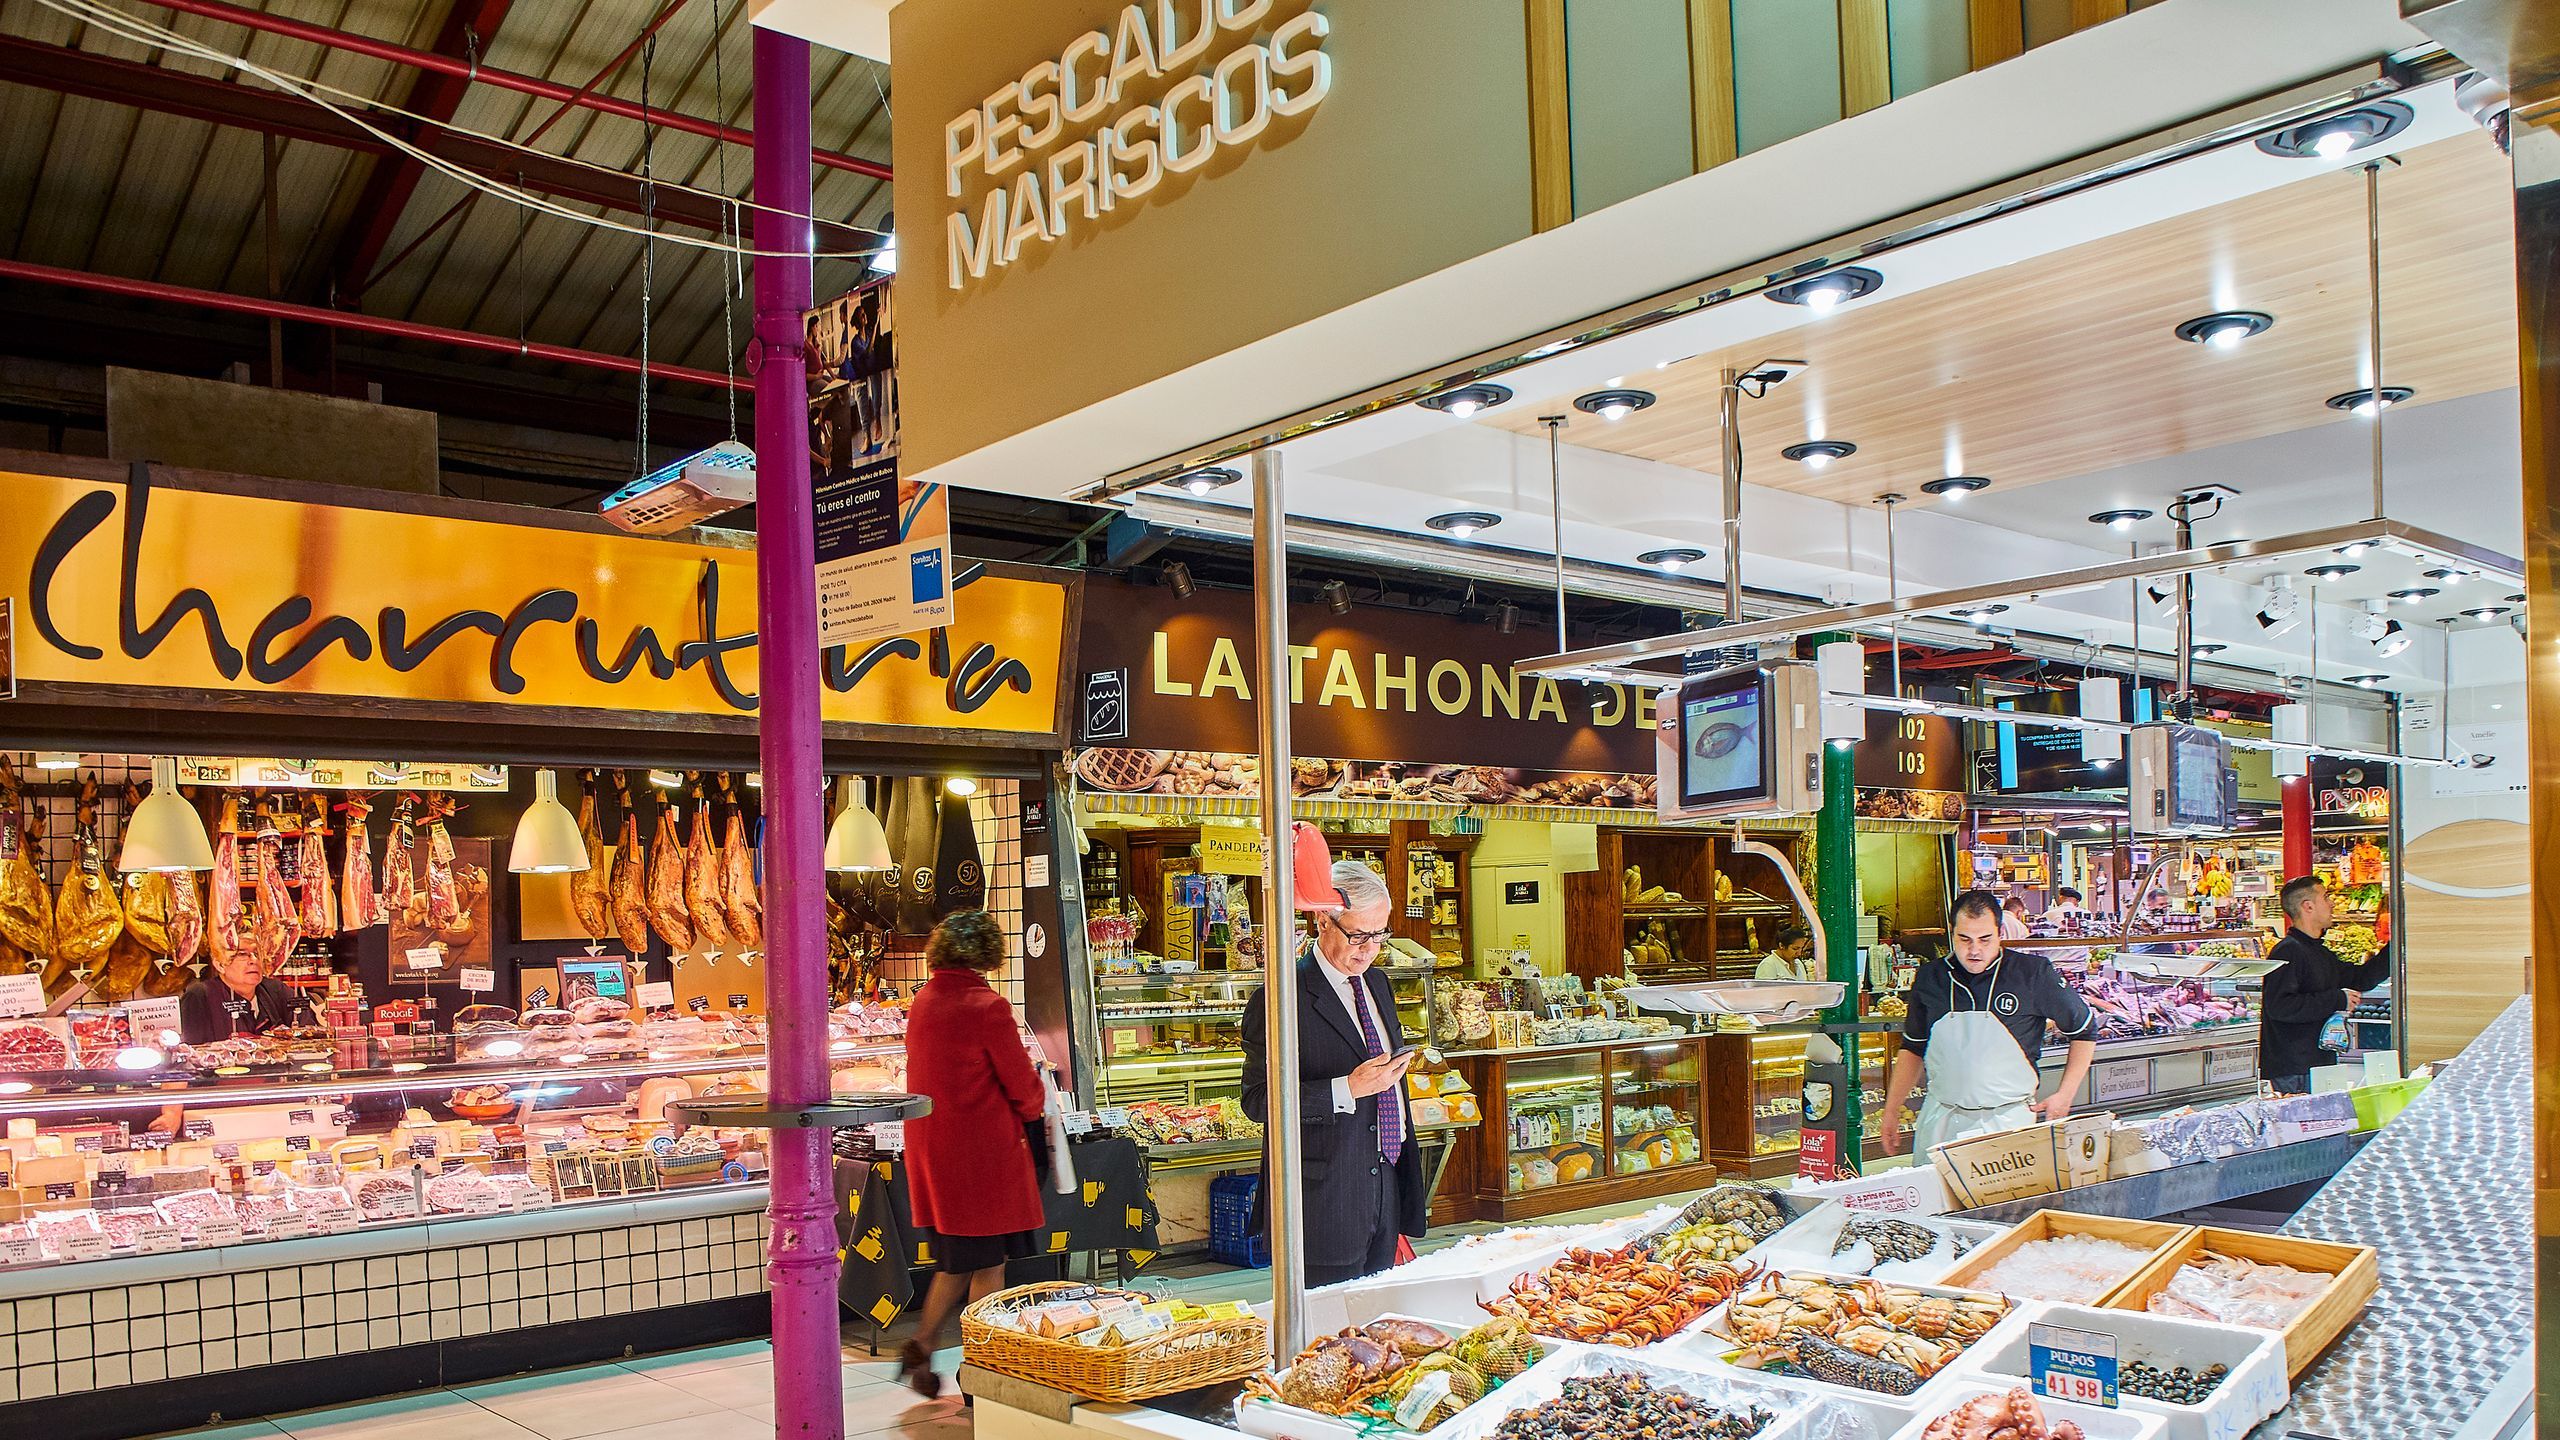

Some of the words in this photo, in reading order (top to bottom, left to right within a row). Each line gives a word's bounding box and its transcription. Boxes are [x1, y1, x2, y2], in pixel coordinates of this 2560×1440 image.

[946, 11, 1332, 290] MARISCOS
[816, 502, 827, 514] Tú
[828, 499, 844, 512] eres
[845, 494, 853, 507] el
[854, 489, 881, 504] centro
[912, 555, 932, 565] Sanitas
[30, 460, 1031, 712] Charcutría
[929, 606, 945, 615] Bupa
[1152, 631, 1252, 701] LA
[1288, 644, 1569, 724] TAHONA
[1593, 682, 1657, 730] DE
[1898, 717, 1926, 740] 102
[1898, 752, 1926, 775] 103
[1026, 804, 1040, 815] Lola
[2320, 786, 2389, 811] PEDR
[137, 1012, 172, 1021] ALAMANCA
[146, 1004, 178, 1013] BELLOTA
[380, 1006, 414, 1019] ROUGIÉ
[2212, 1064, 2227, 1076] Gran
[2100, 1080, 2118, 1096] Gran
[1802, 1136, 1820, 1147] Lola
[1970, 1150, 2036, 1179] Amélie
[592, 1162, 621, 1191] NCHOAS
[2050, 1350, 2097, 1368] PULPOS
[2048, 1375, 2070, 1396] 41
[2076, 1379, 2098, 1399] 98
